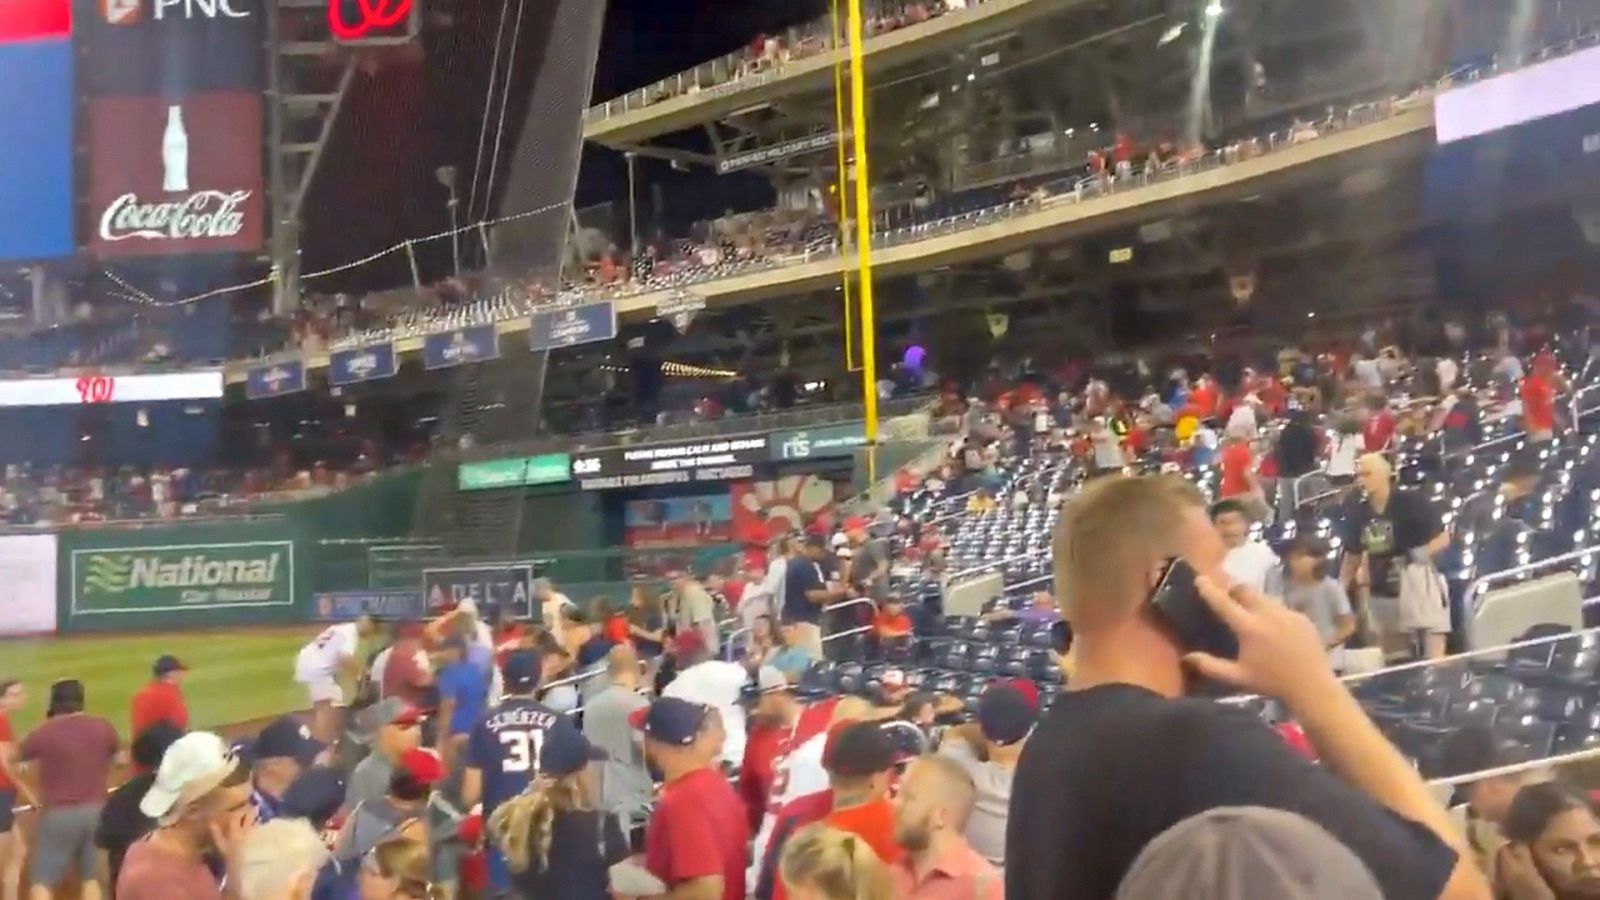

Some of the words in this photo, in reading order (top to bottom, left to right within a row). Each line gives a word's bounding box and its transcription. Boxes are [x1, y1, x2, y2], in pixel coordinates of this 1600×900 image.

[129, 553, 280, 588] National
[451, 579, 527, 604] DELTA
[499, 729, 544, 773] 31
